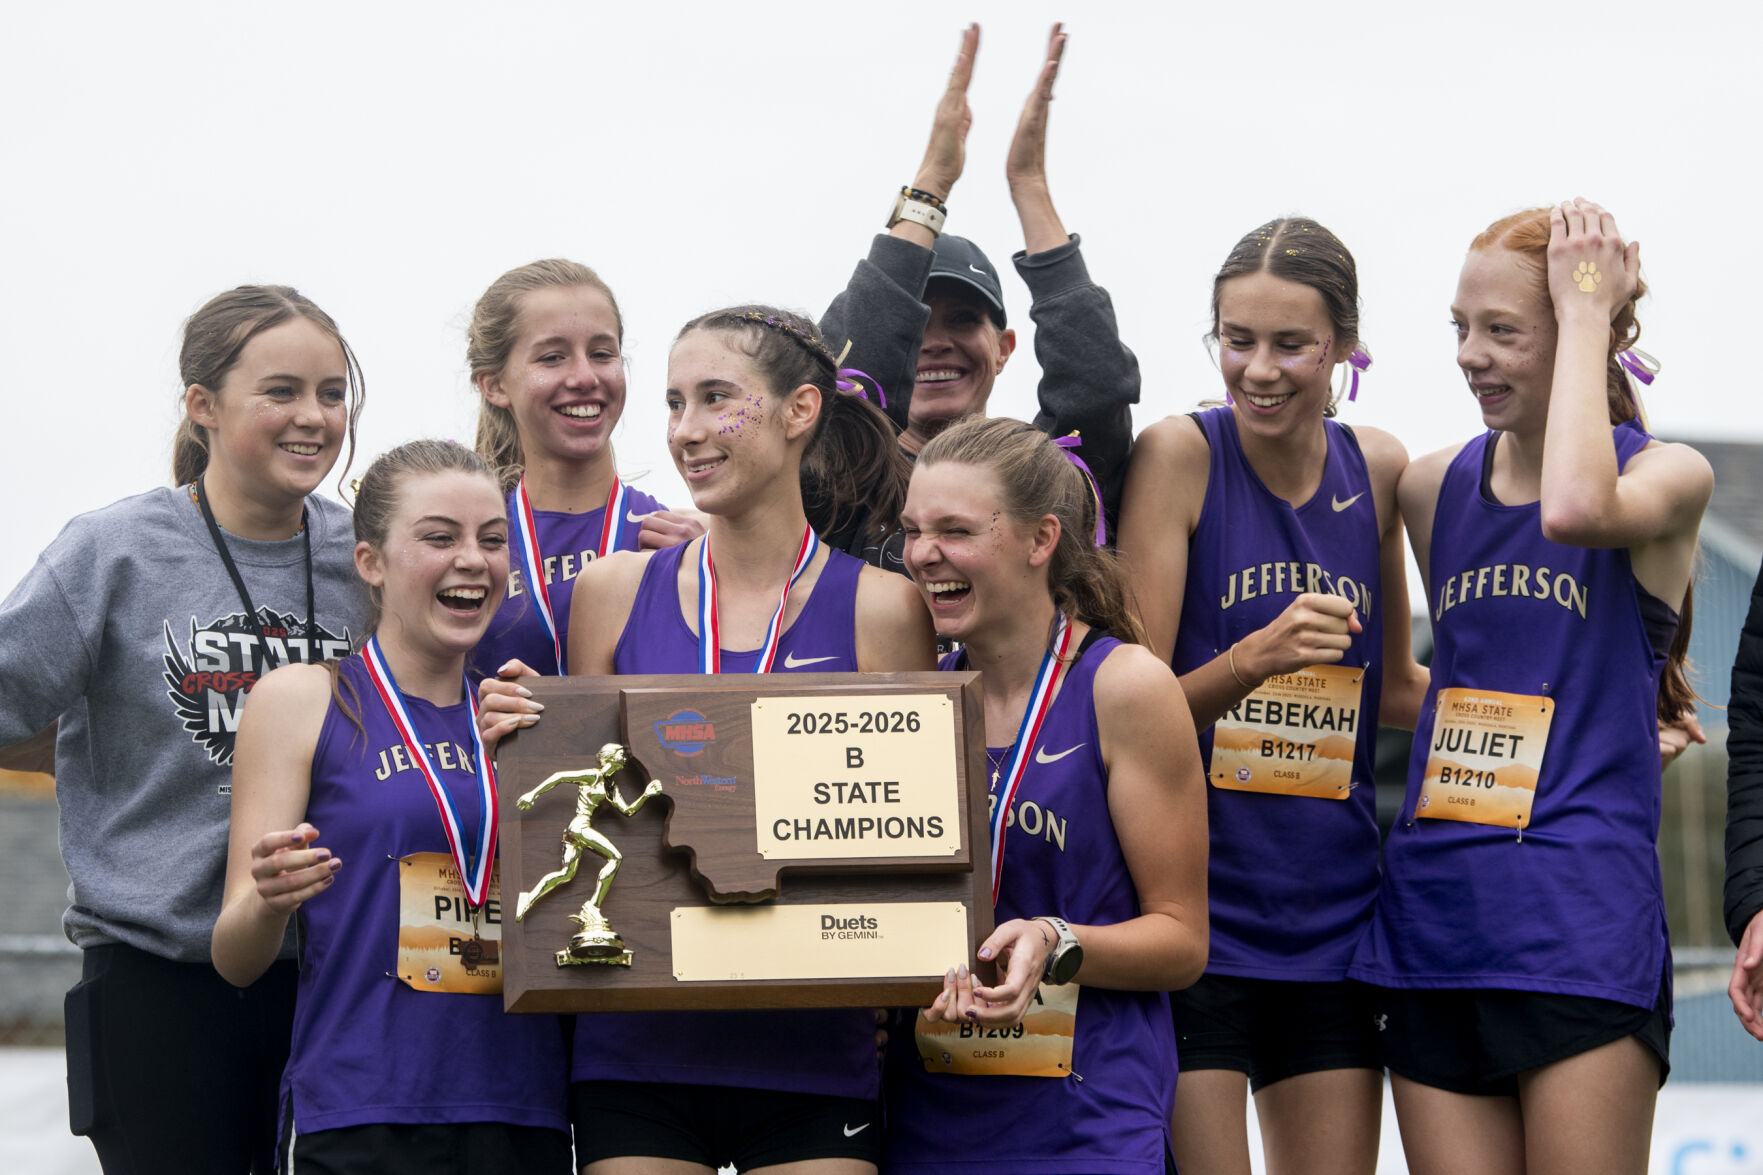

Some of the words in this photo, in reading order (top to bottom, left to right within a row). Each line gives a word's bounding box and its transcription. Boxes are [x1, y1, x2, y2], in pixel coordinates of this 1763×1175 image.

[1220, 561, 1373, 622] JEFFERSON
[1435, 564, 1589, 622] JEFFERSON
[1297, 676, 1327, 689] STATE
[1222, 698, 1356, 733] REBEKAH
[1452, 702, 1478, 713] MHSA
[1482, 704, 1513, 717] STATE
[665, 723, 716, 741] MHSA
[786, 710, 921, 735] 2025-2026
[1260, 739, 1316, 762] B1217
[1434, 727, 1524, 759] JULIET
[845, 747, 865, 769] B
[1273, 770, 1295, 779] CLASS
[1439, 766, 1496, 789] B1210
[813, 781, 901, 804] STATE
[1448, 796, 1470, 806] CLASS
[772, 815, 945, 841] CHAMPIONS
[821, 915, 878, 930] Duets
[821, 931, 836, 940] BY
[837, 931, 878, 940] GEMINI
[466, 969, 490, 977] CLASS
[973, 1050, 998, 1059] CLASS
